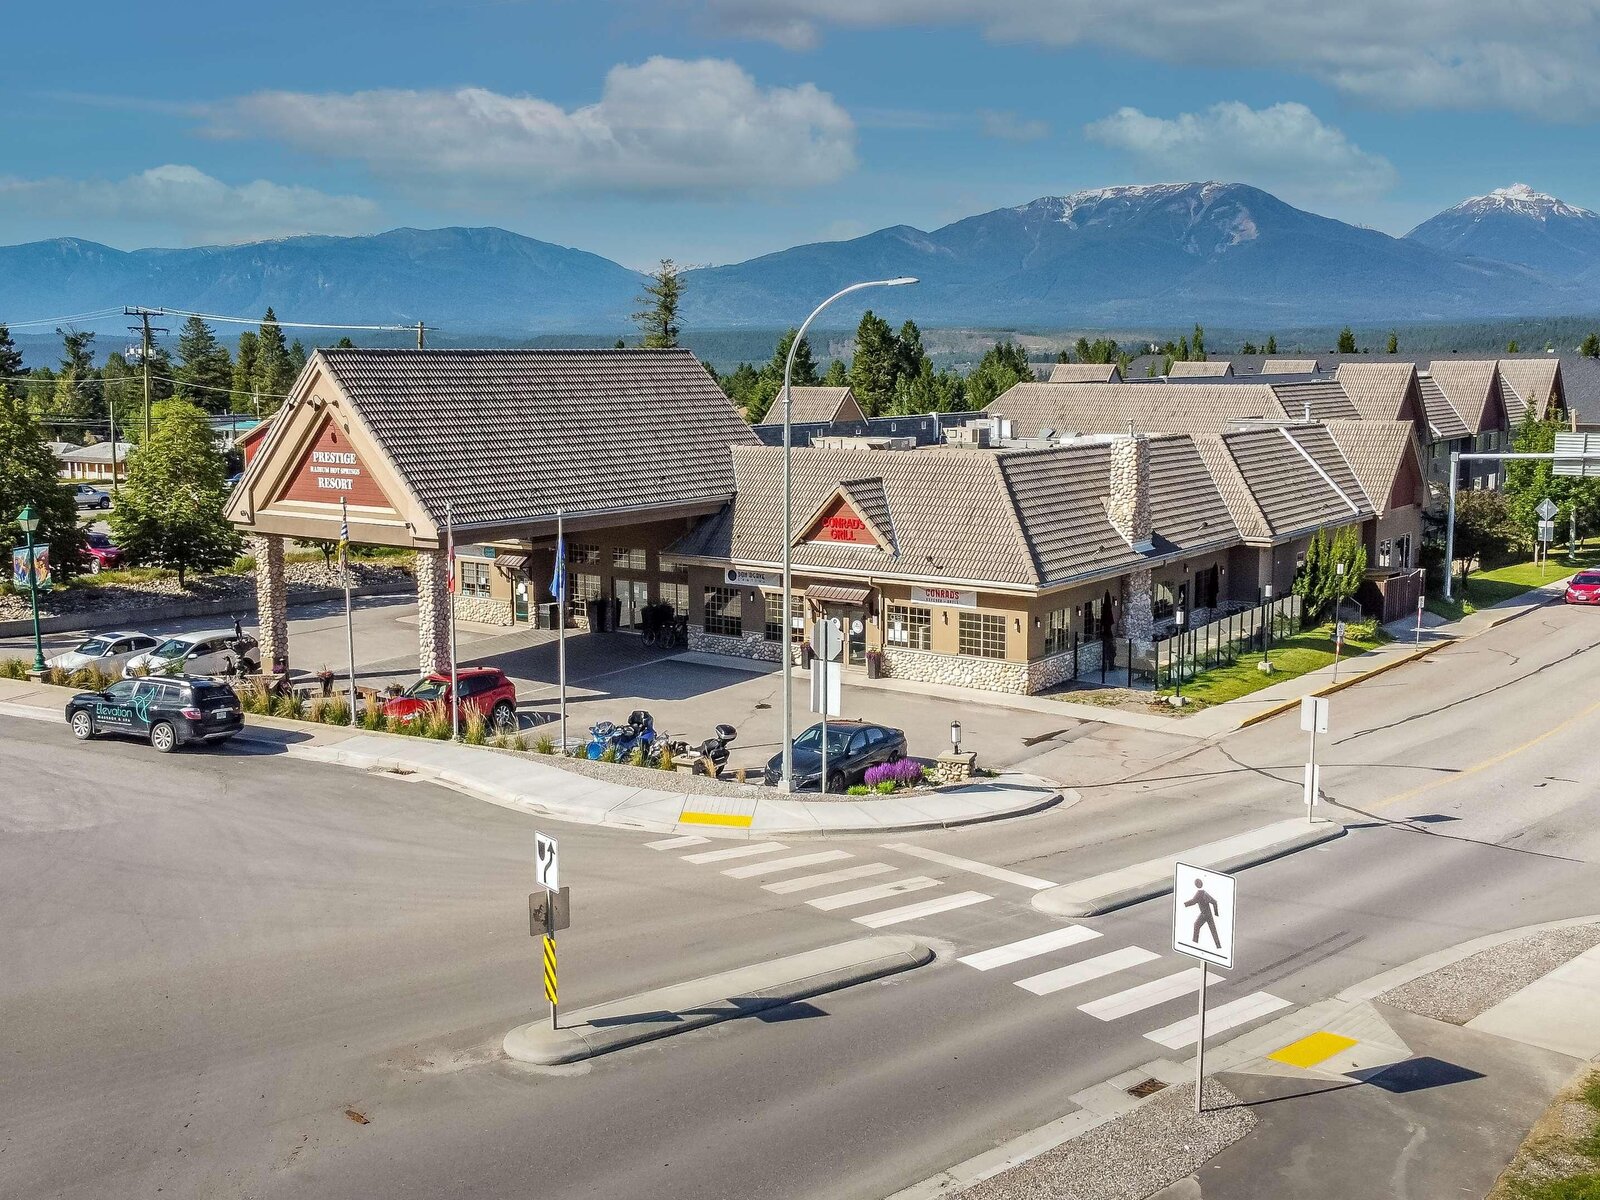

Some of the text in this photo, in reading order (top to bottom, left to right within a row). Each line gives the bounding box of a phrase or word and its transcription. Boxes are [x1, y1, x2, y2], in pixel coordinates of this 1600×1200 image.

[313, 451, 357, 465] PRESTIGE
[317, 477, 354, 490] RESORT
[822, 516, 866, 530] CONRAD'S
[831, 529, 857, 541] GRILL
[96, 702, 133, 718] Elevation
